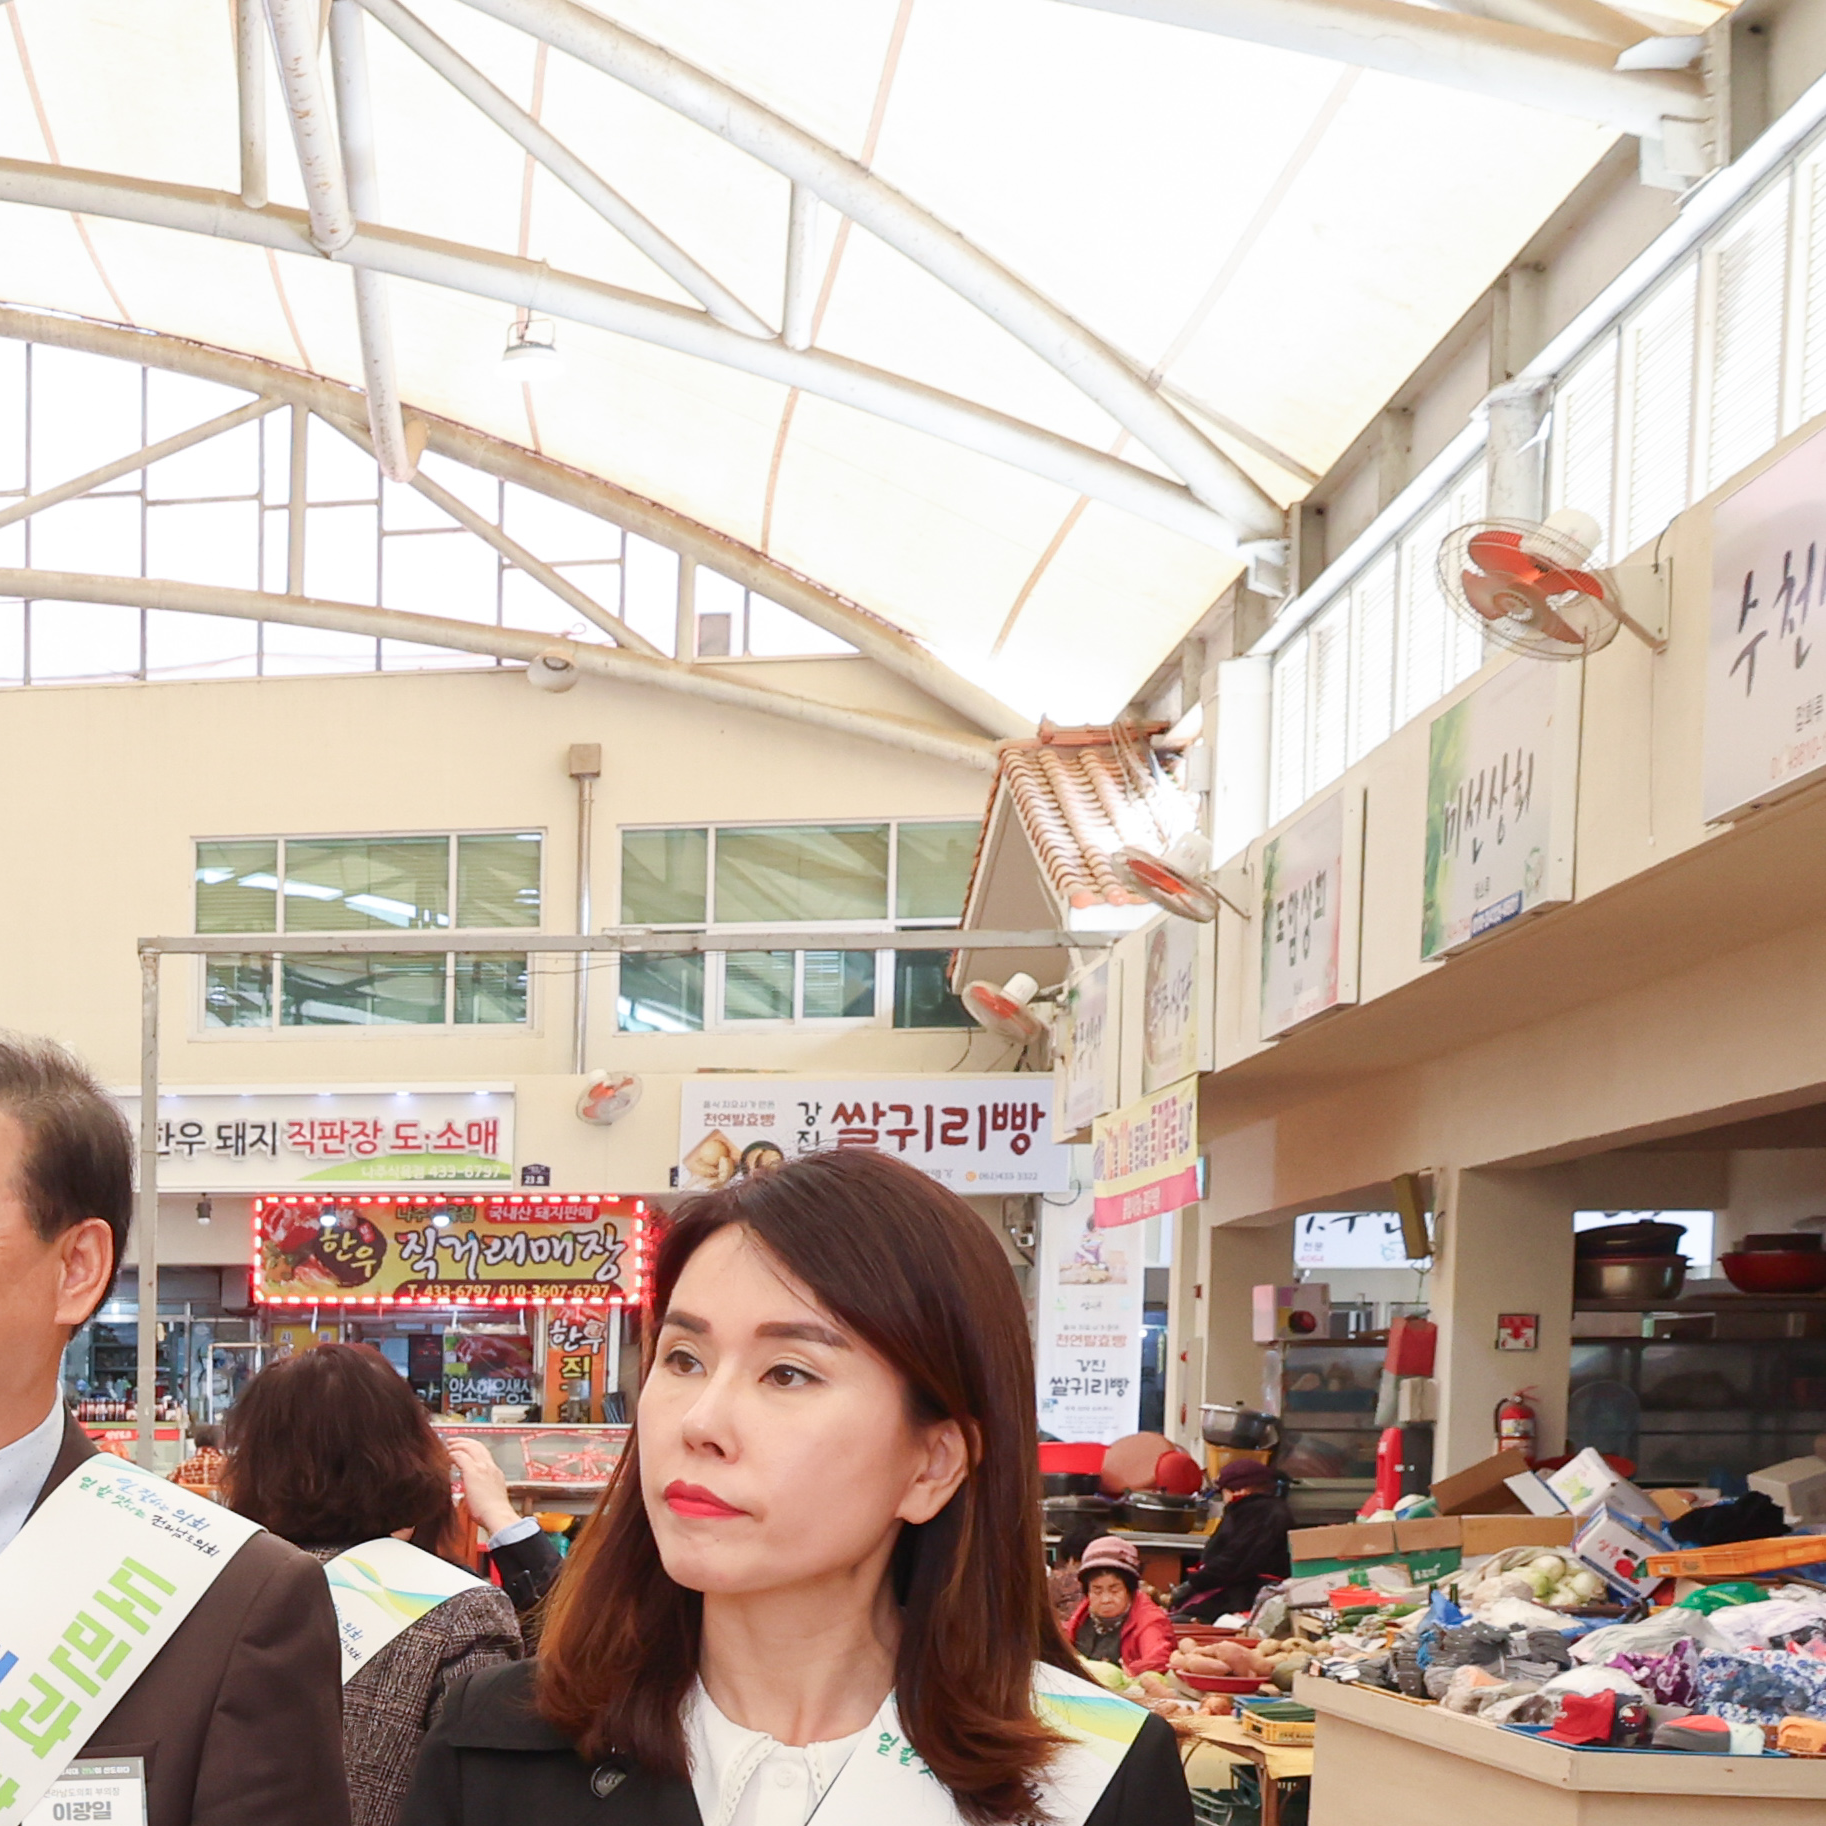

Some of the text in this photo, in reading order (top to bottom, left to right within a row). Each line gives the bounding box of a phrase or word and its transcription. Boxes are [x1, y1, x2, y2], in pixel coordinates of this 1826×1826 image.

[1444, 746, 1534, 866] 미선상회
[702, 1112, 776, 1128] 천연발효빵
[796, 1101, 823, 1151] 강진
[830, 1101, 1047, 1156] 쌀귀리빵
[216, 1121, 278, 1157] 돼지
[285, 1118, 384, 1156] 직판장
[428, 1165, 502, 1180] 433-6797
[487, 1206, 534, 1221] 국내산
[318, 1225, 376, 1281] 한우
[395, 1223, 628, 1282] 직거래매장
[499, 1284, 610, 1299] 010-3607-6797
[548, 1319, 606, 1353] 한우
[1055, 1333, 1128, 1348] 천연발효빵
[1075, 1359, 1106, 1373] 강진
[1049, 1376, 1130, 1398] 쌀귀리빵
[171, 1508, 211, 1533] 의회
[52, 1801, 112, 1821] 이광일
